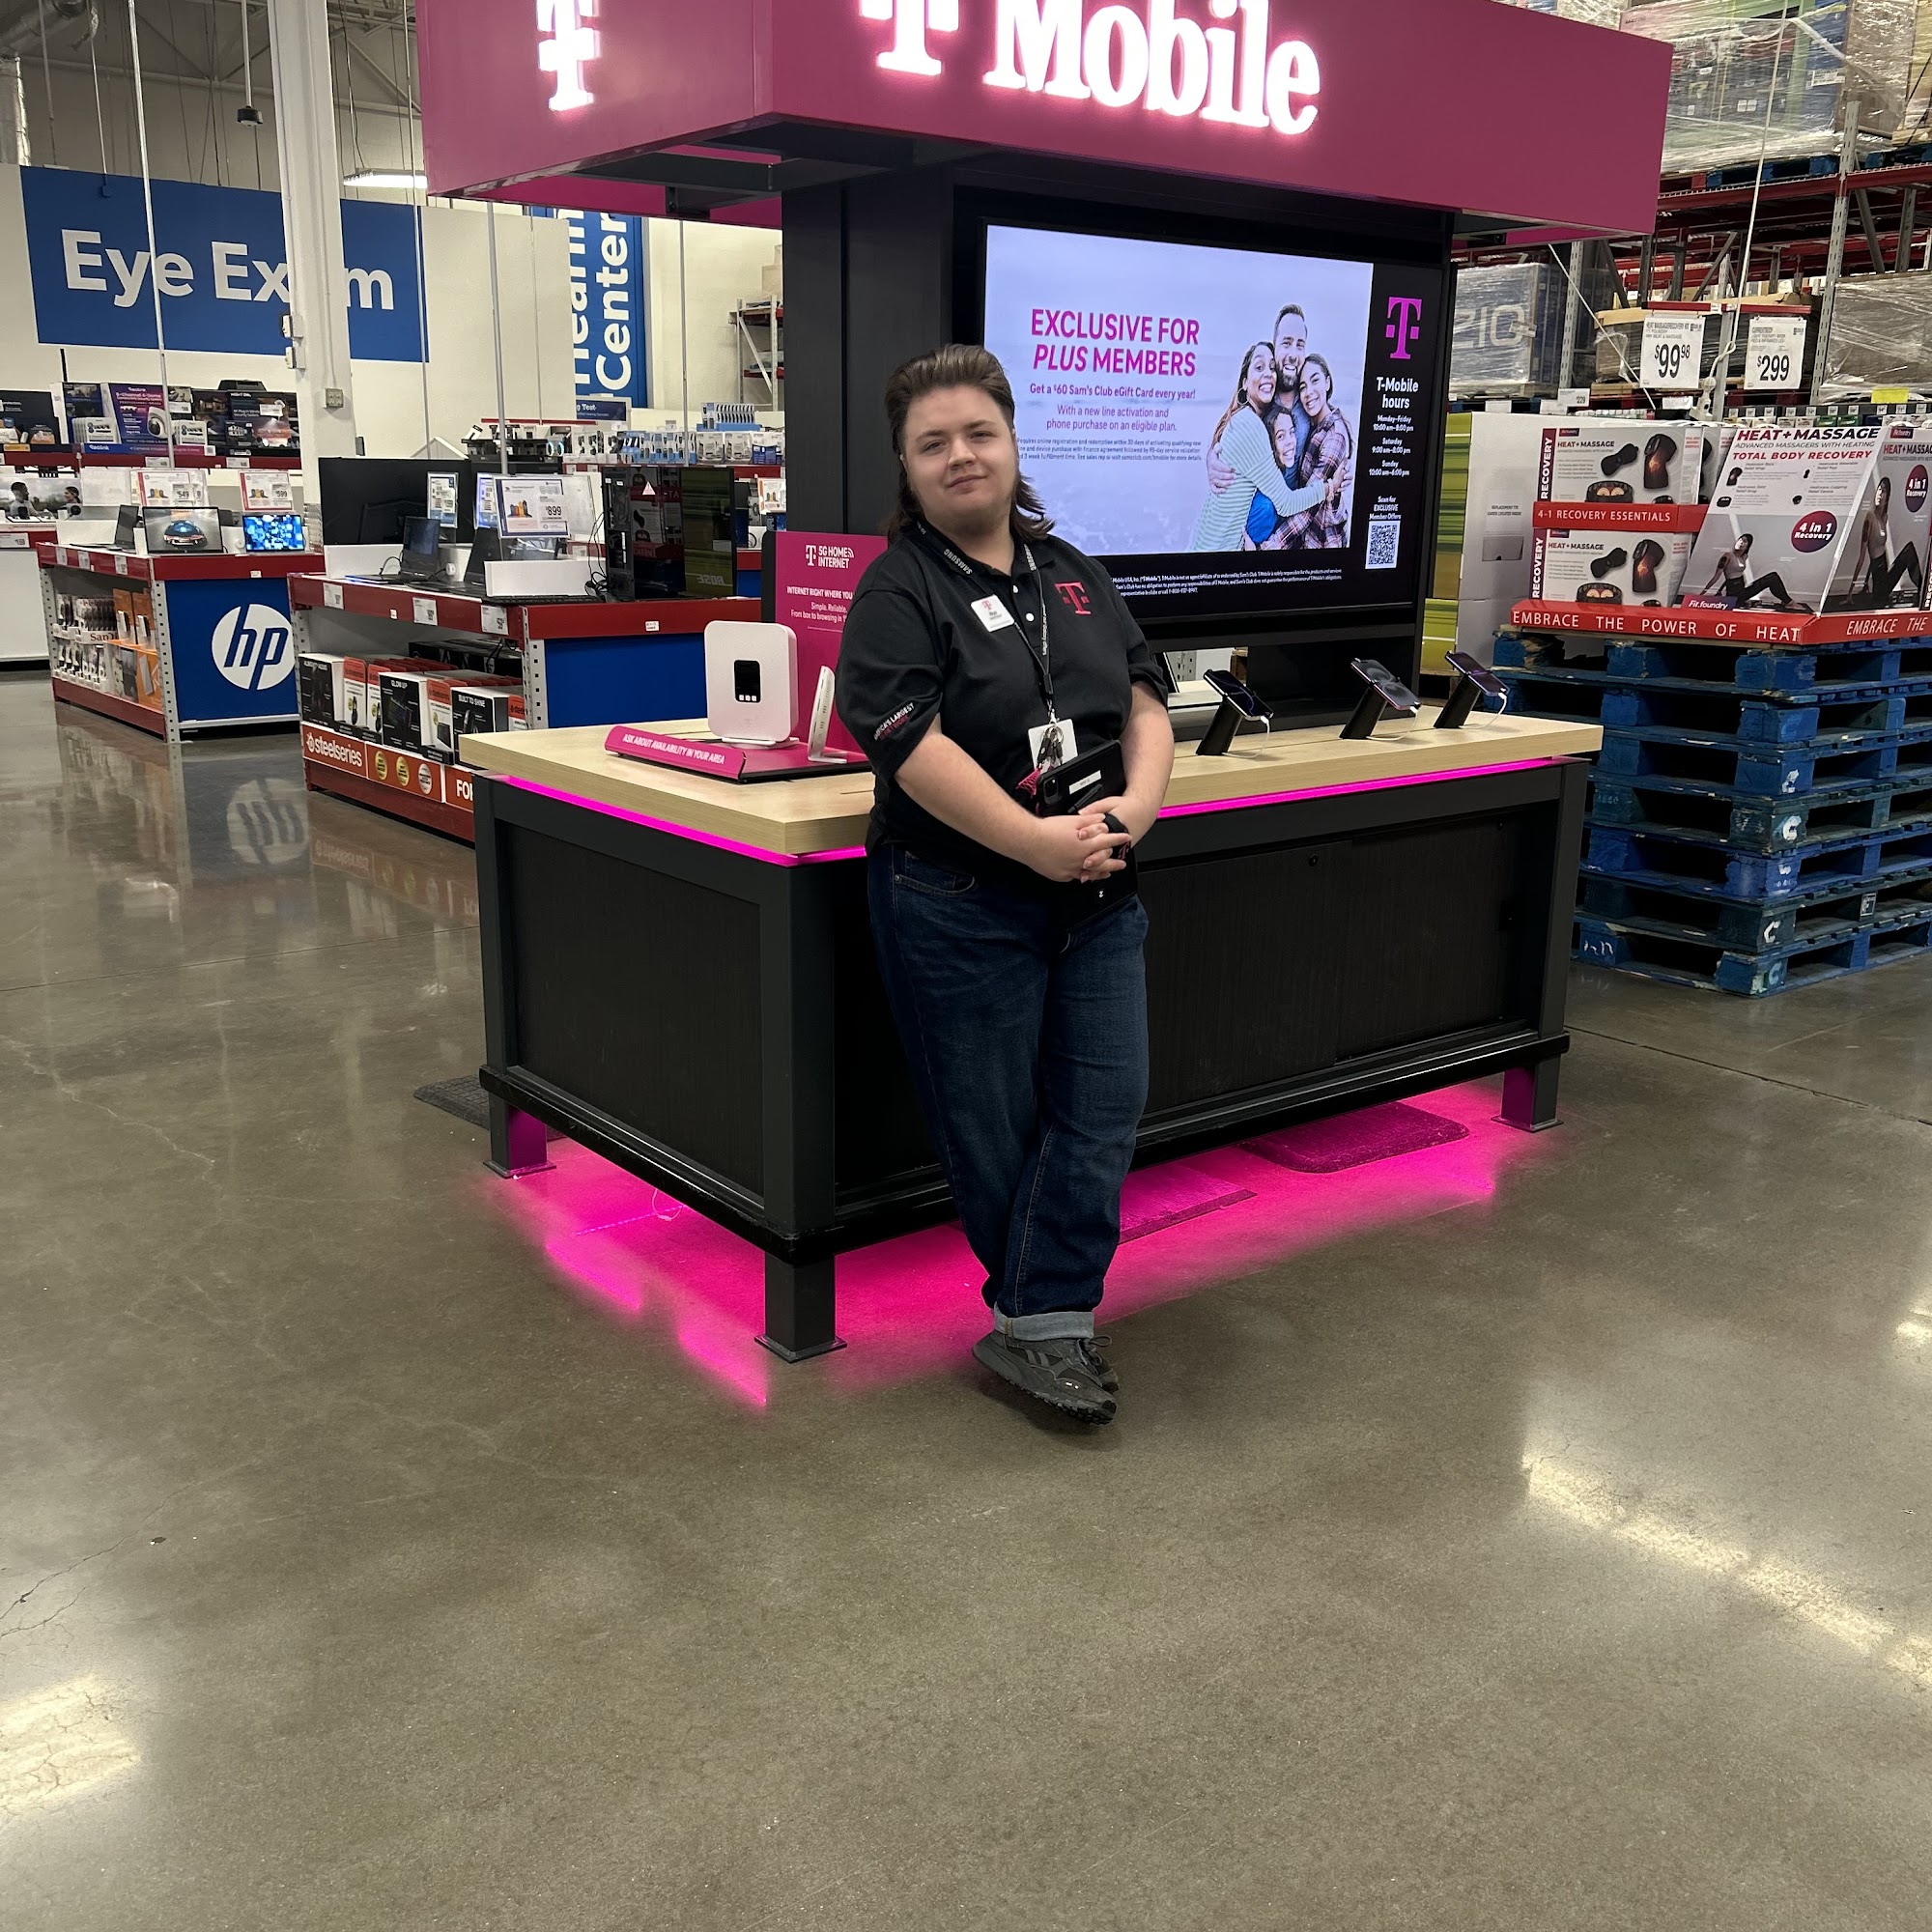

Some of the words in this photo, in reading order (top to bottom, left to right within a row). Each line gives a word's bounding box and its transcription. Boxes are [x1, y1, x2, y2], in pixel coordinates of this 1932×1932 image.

[982, 0, 1321, 134] Mobile
[62, 229, 194, 308] Eye
[212, 241, 394, 311] Exm
[596, 212, 632, 390] Center
[1031, 308, 1152, 342] EXCLUSIVE
[1158, 317, 1200, 345] FOR
[1385, 297, 1422, 359] T
[1452, 305, 1525, 348] ZIO
[1033, 344, 1088, 372] PLUS
[1093, 347, 1196, 377] MEMBERS
[1756, 355, 1790, 382] $299
[1030, 383, 1044, 394] Get
[1053, 384, 1066, 395] $60
[1069, 384, 1093, 396] Sam's
[1094, 385, 1112, 396] Club
[1114, 386, 1133, 397] eGift
[1135, 387, 1153, 398] Card
[1154, 390, 1176, 401] every
[1177, 389, 1196, 401] year!
[1377, 377, 1419, 392] T-Mobile
[1057, 404, 1076, 415] With
[1084, 408, 1100, 416] new
[1101, 406, 1115, 416] line
[1117, 406, 1153, 417] activation
[1154, 408, 1169, 418] and
[1381, 394, 1410, 409] hours
[1046, 419, 1071, 431] phone
[1072, 419, 1108, 432] purchase
[1121, 422, 1130, 431] an
[1131, 419, 1157, 432] eligible
[1159, 420, 1178, 433] plan.
[1733, 452, 1767, 461] TOTAL
[1771, 451, 1804, 460] BODY
[1807, 450, 1873, 460] RECOVERY
[1541, 437, 1553, 500] RECOVERY
[1556, 510, 1608, 521] RECOVERY
[1610, 511, 1671, 522] ESSENTIALS
[1799, 523, 1807, 532] 4
[1810, 523, 1823, 532] in
[1825, 523, 1833, 532] 1
[1794, 531, 1833, 541] Recovery
[806, 545, 817, 567] T
[818, 546, 828, 556] 5G
[828, 547, 848, 558] HOME
[817, 556, 850, 569] INTERNET
[943, 548, 973, 575] SAMSUNG
[1532, 537, 1545, 599] RECOVERY
[786, 585, 810, 596] INTERNET
[810, 587, 824, 597] RIGHT
[824, 589, 842, 600] WHERE
[842, 591, 853, 600] YOU
[1054, 582, 1092, 615] T
[790, 609, 802, 618] From
[1689, 599, 1728, 611] Fit.foundry
[1513, 611, 1579, 628] EMBRACE
[1596, 615, 1624, 631] THE
[1641, 618, 1697, 636] POWER
[1715, 623, 1737, 638] OF
[1756, 626, 1801, 642] HEAT
[1846, 617, 1898, 636] EMBRACE
[1906, 616, 1928, 632] THE
[223, 604, 289, 691] hp
[890, 702, 915, 724] LARGEST
[315, 735, 363, 768] steelseries
[622, 734, 635, 745] ASK
[634, 736, 654, 748] ABOUT
[651, 739, 689, 756] AVAILABILITY
[686, 748, 695, 758] IN
[694, 749, 710, 761] YOUR
[708, 753, 725, 765] AREA
